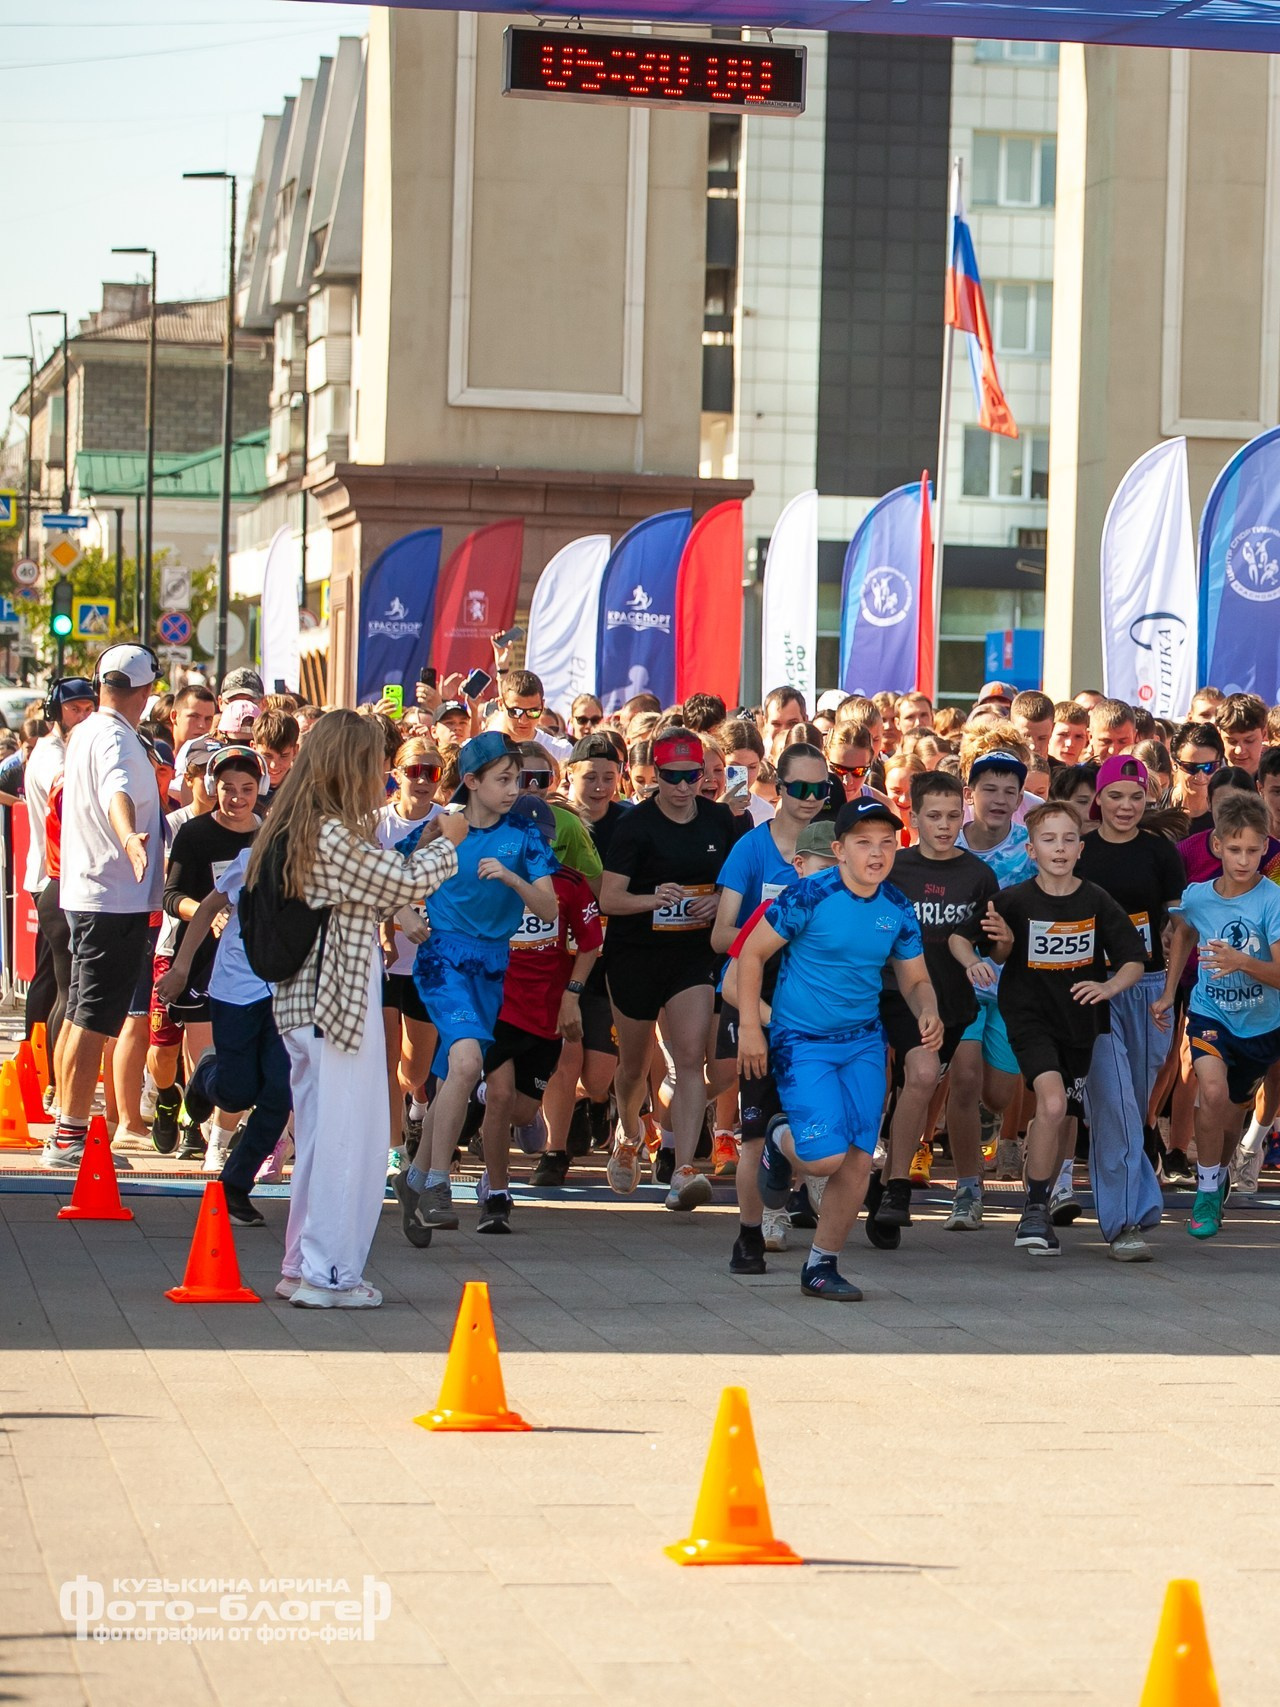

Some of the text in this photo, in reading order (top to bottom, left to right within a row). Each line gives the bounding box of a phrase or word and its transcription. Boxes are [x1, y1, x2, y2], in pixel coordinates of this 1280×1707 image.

[608, 610, 671, 627] КРАССПОРТ
[1034, 933, 1091, 955] 3255
[1205, 984, 1264, 1003] BRDNG
